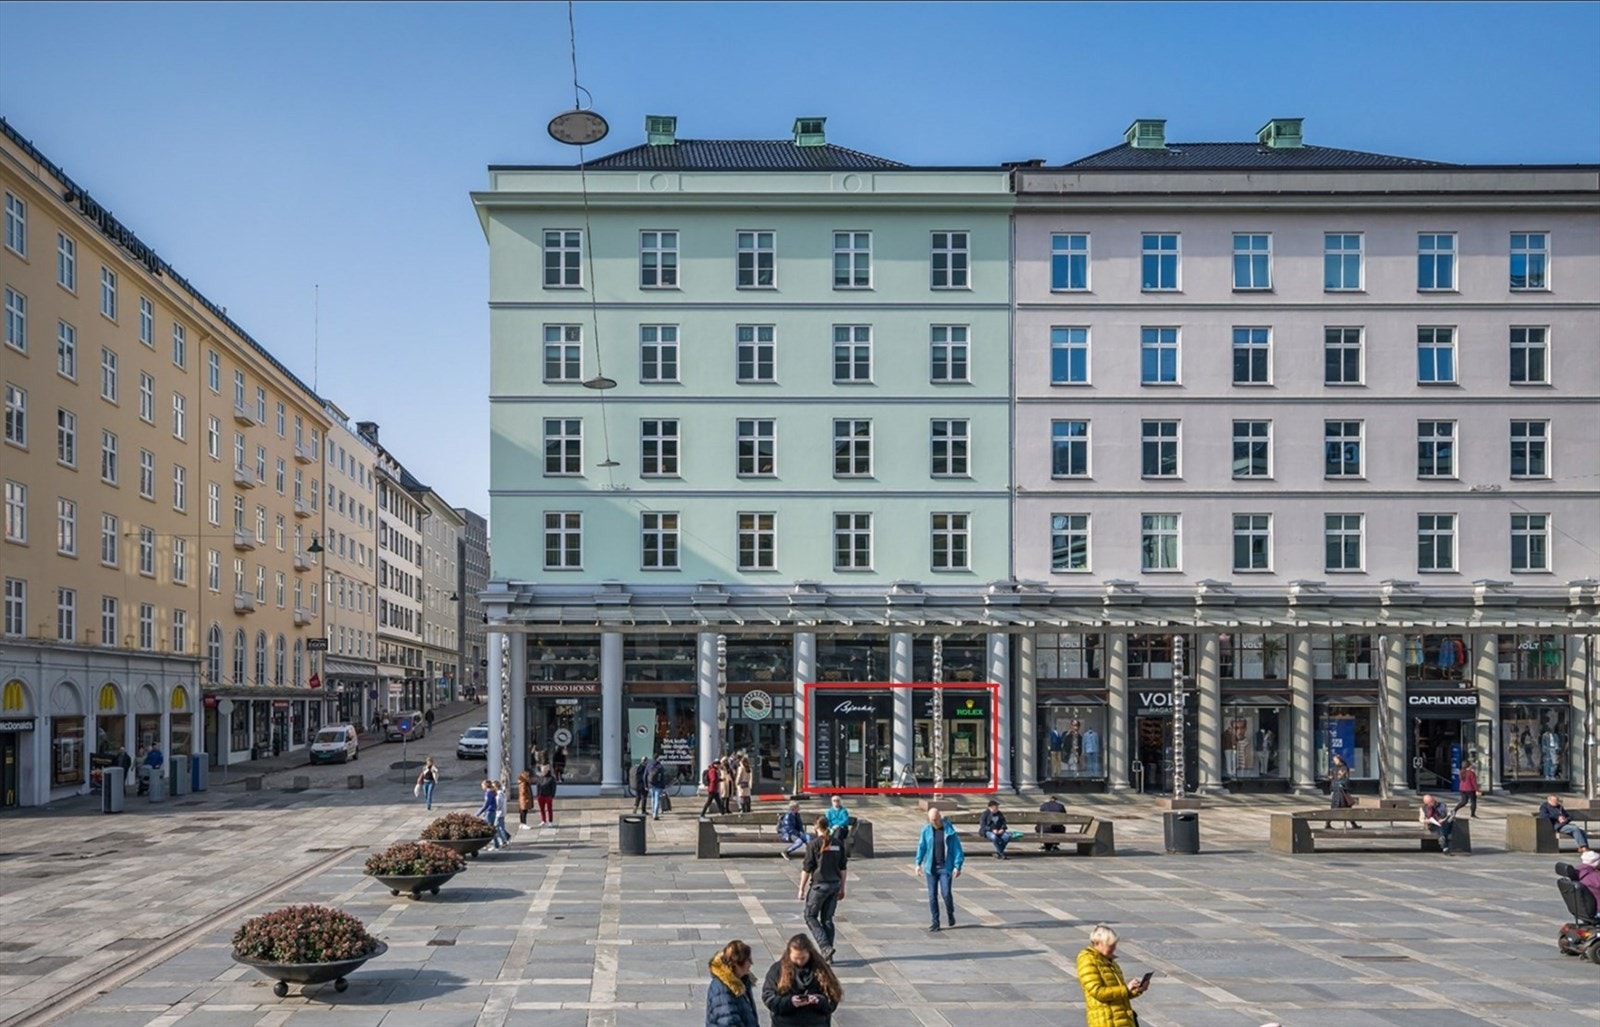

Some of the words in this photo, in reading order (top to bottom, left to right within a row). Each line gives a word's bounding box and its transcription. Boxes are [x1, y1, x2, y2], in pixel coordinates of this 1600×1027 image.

[531, 684, 568, 692] ESPRESSO
[569, 684, 597, 692] HOUSE
[1139, 692, 1190, 706] VOLT
[1409, 696, 1477, 705] CARLINGS
